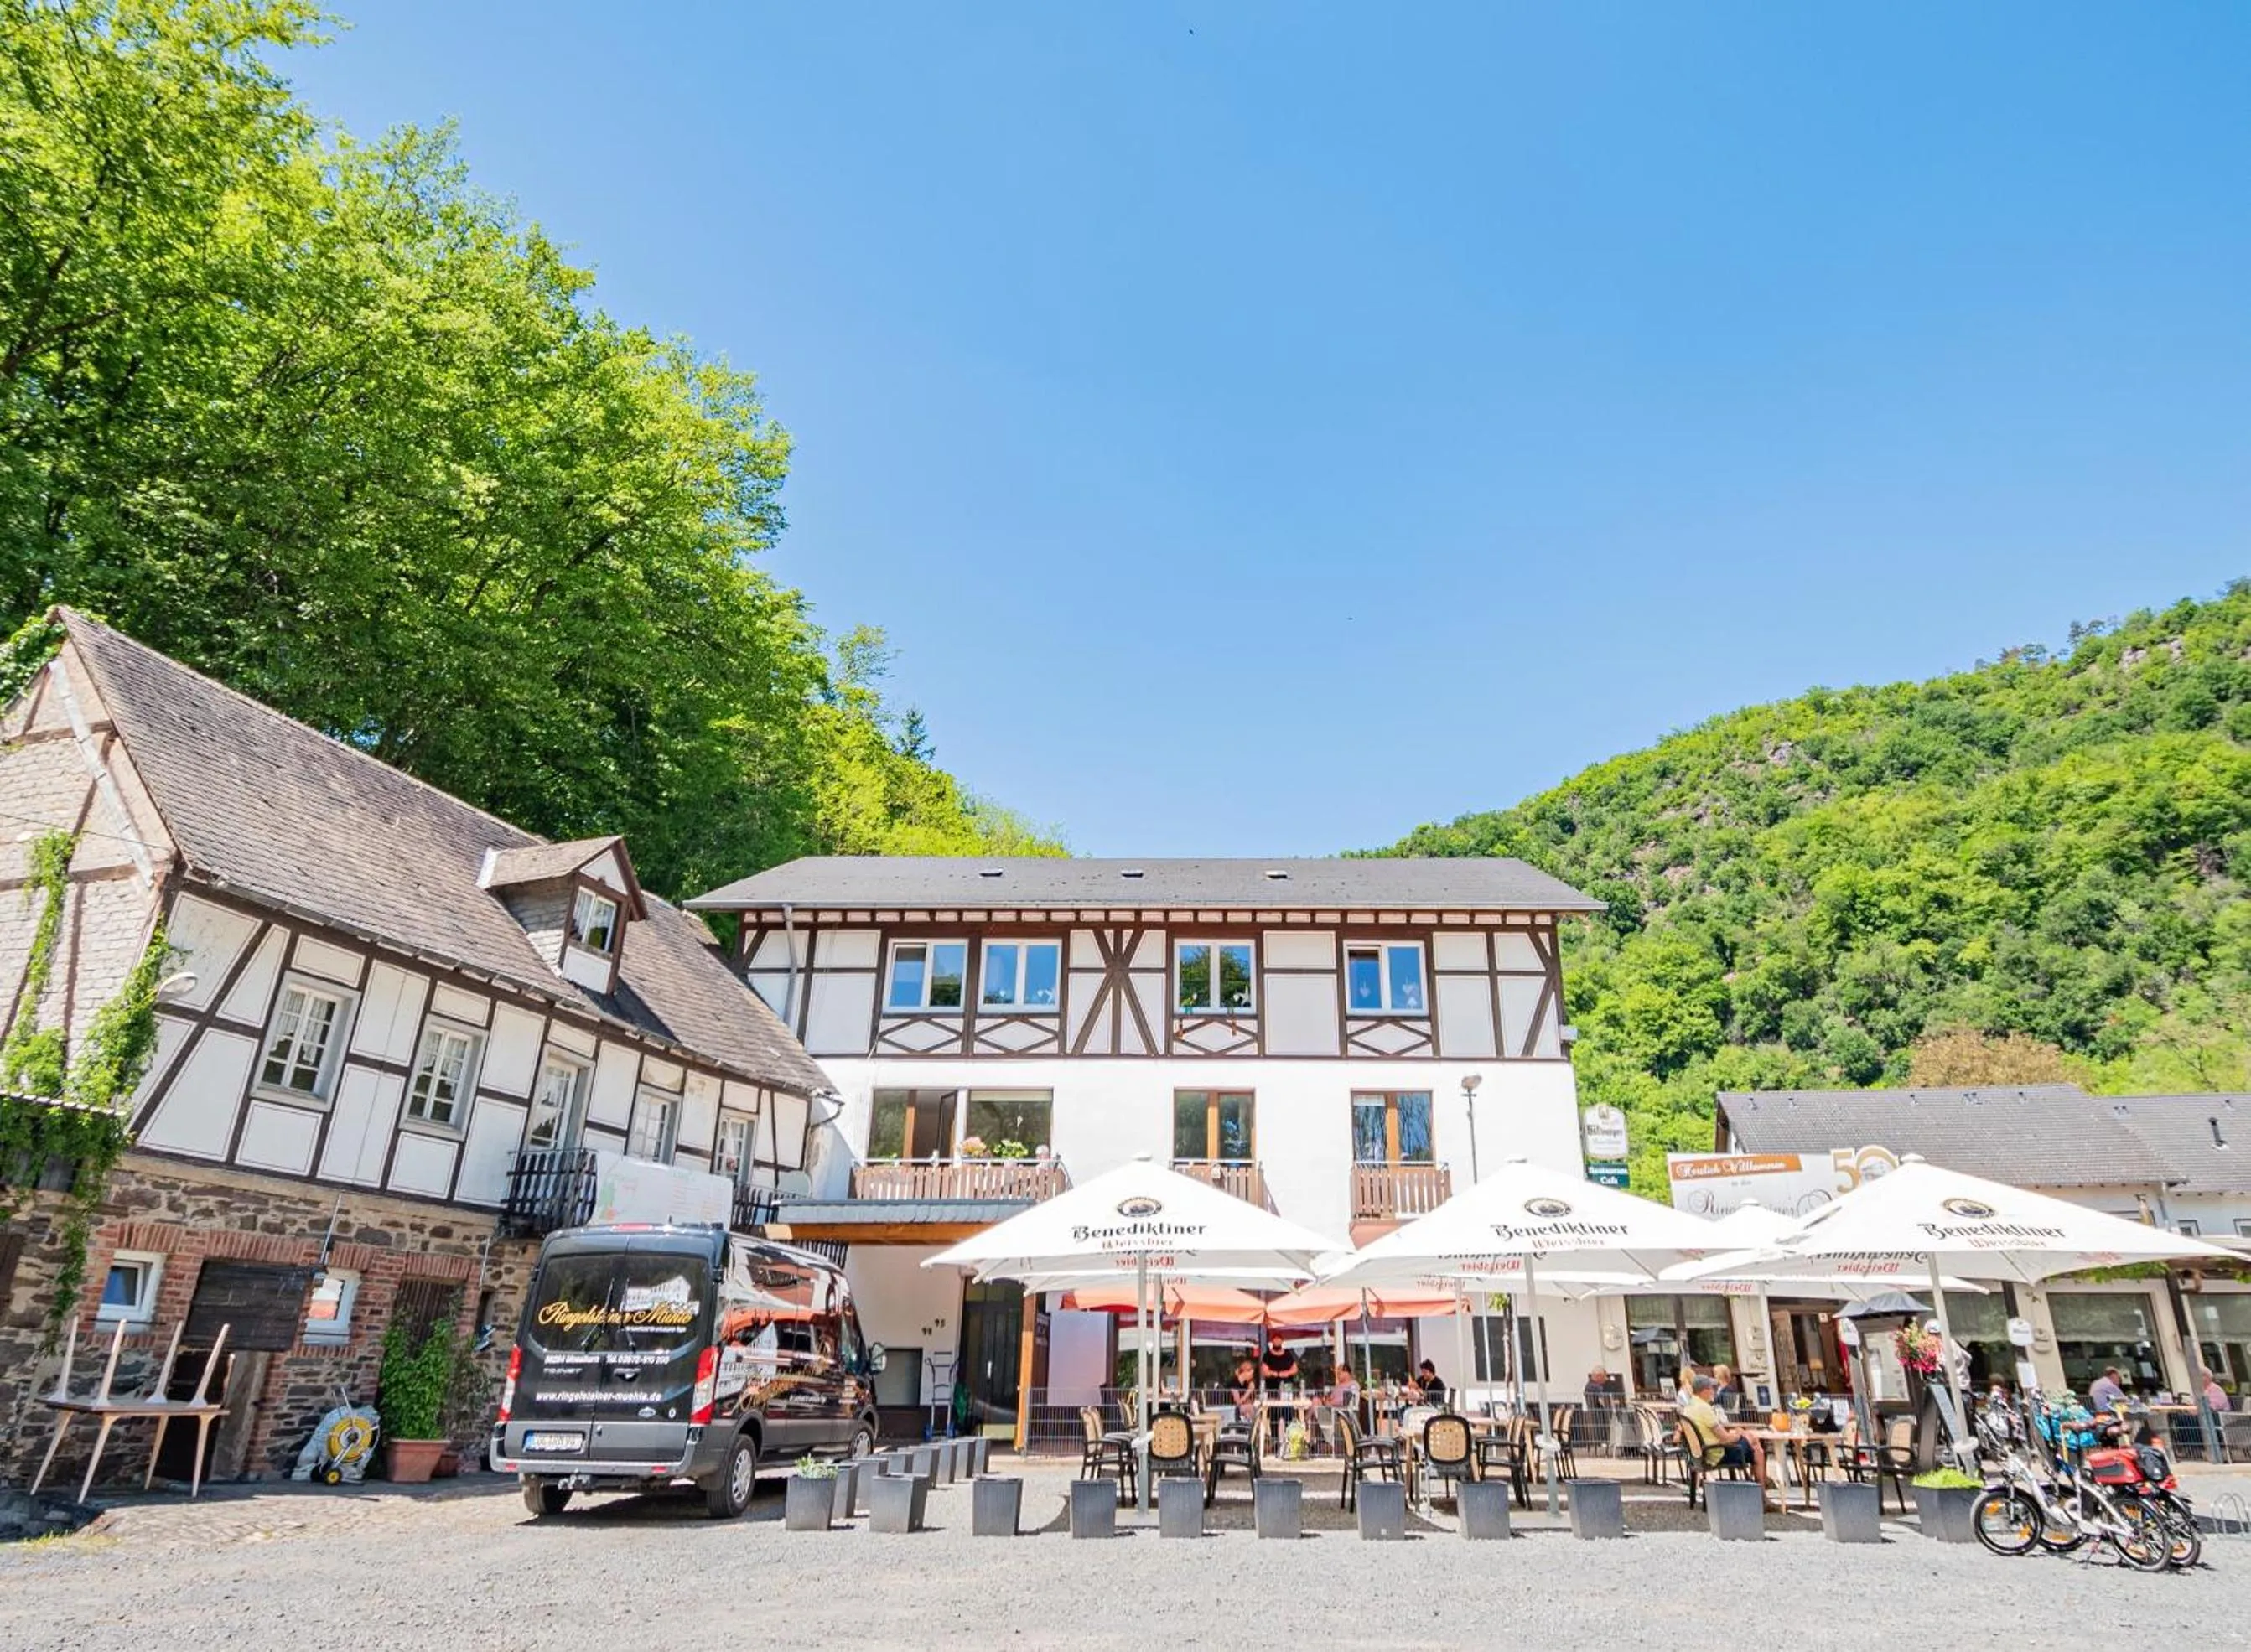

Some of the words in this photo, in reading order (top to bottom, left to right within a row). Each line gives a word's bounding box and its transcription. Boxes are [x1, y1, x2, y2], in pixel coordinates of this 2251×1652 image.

[1676, 1162, 1721, 1178] Herzlich
[1722, 1158, 1786, 1173] Willkommen
[1071, 1222, 1206, 1243] Benediktiner
[1490, 1222, 1629, 1241] Benediktiner
[1917, 1222, 2067, 1240] Benediktiner
